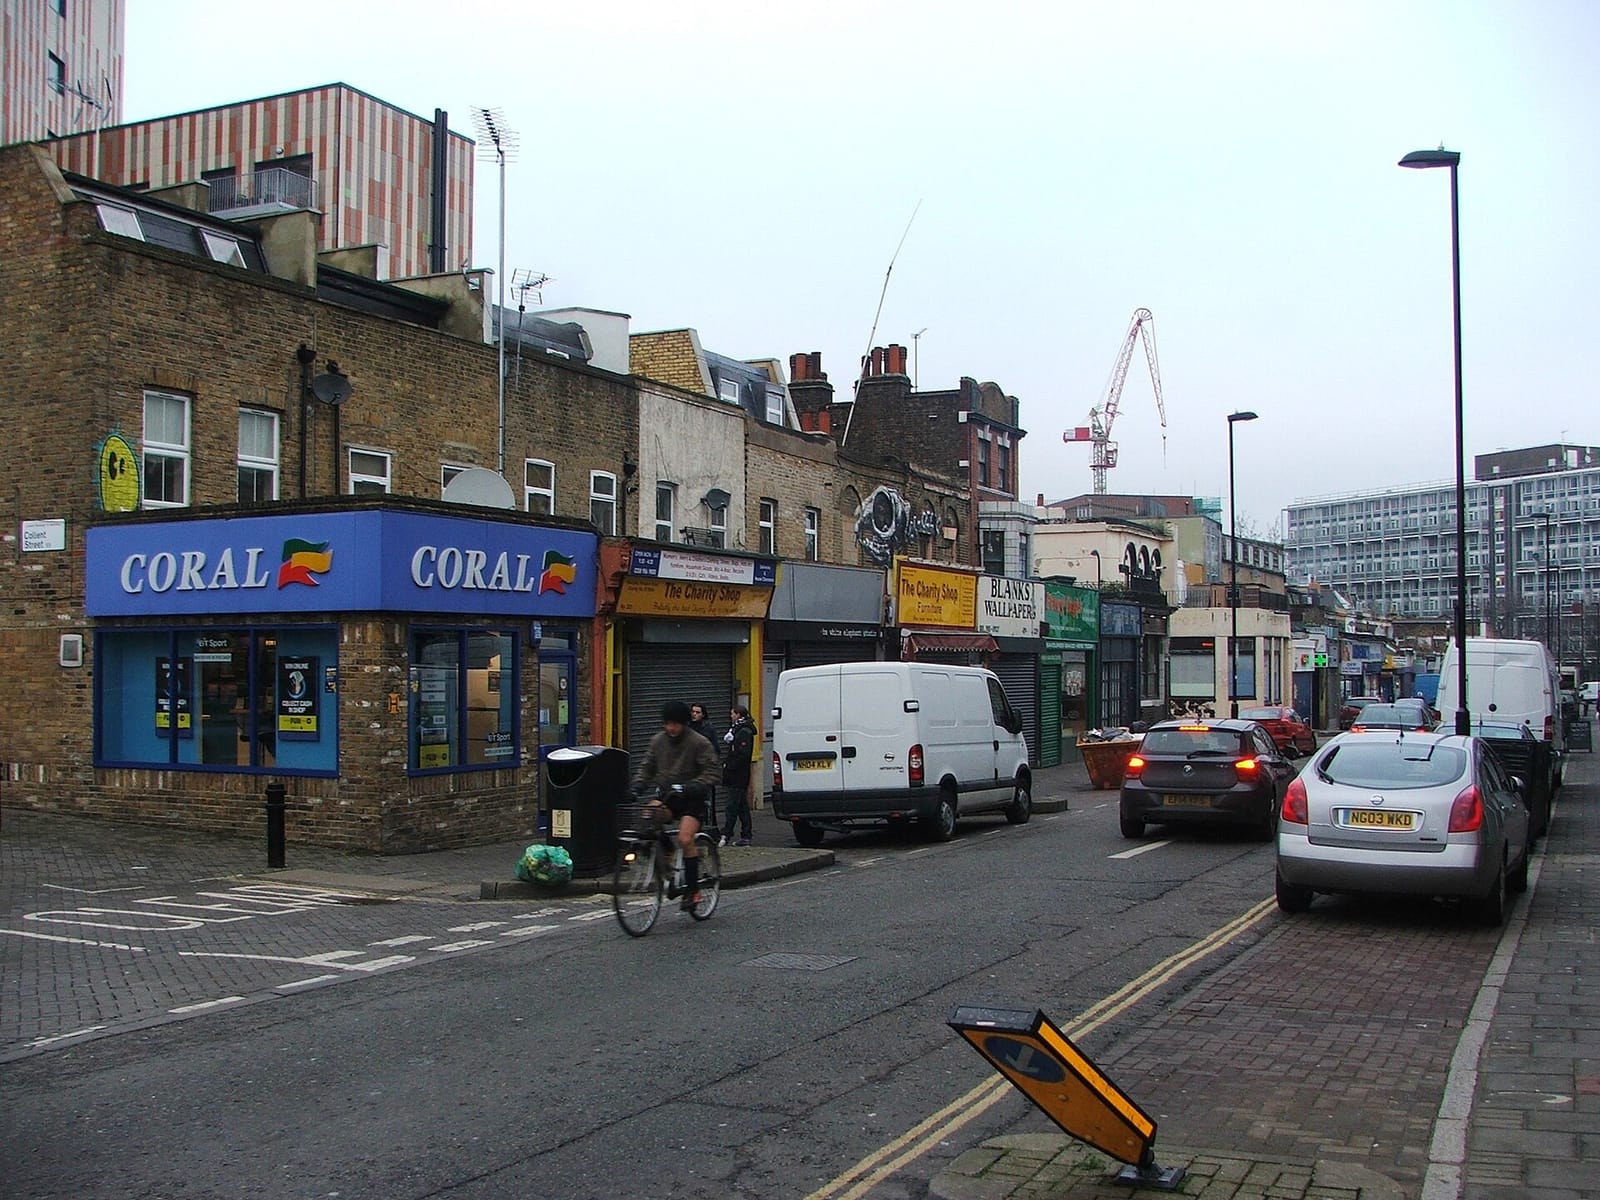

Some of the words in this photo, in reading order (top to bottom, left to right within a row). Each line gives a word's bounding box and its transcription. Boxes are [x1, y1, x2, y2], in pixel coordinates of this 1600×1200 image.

[24, 541, 44, 549] Street
[120, 547, 270, 593] CORAL
[411, 545, 534, 592] CORAL
[664, 583, 682, 599] The
[684, 584, 718, 603] Charity
[719, 587, 741, 605] Shop
[902, 579, 915, 597] The
[916, 581, 940, 602] Charity
[941, 583, 958, 604] Shop
[991, 579, 1030, 601] BLANKS
[917, 601, 942, 615] Furniture
[984, 600, 1036, 619] WALLPAPERS
[209, 639, 228, 648] Sport
[496, 733, 511, 743] Sport
[1351, 812, 1384, 824] NG03
[1387, 813, 1412, 826] WKD
[23, 885, 400, 931] CLEAR
